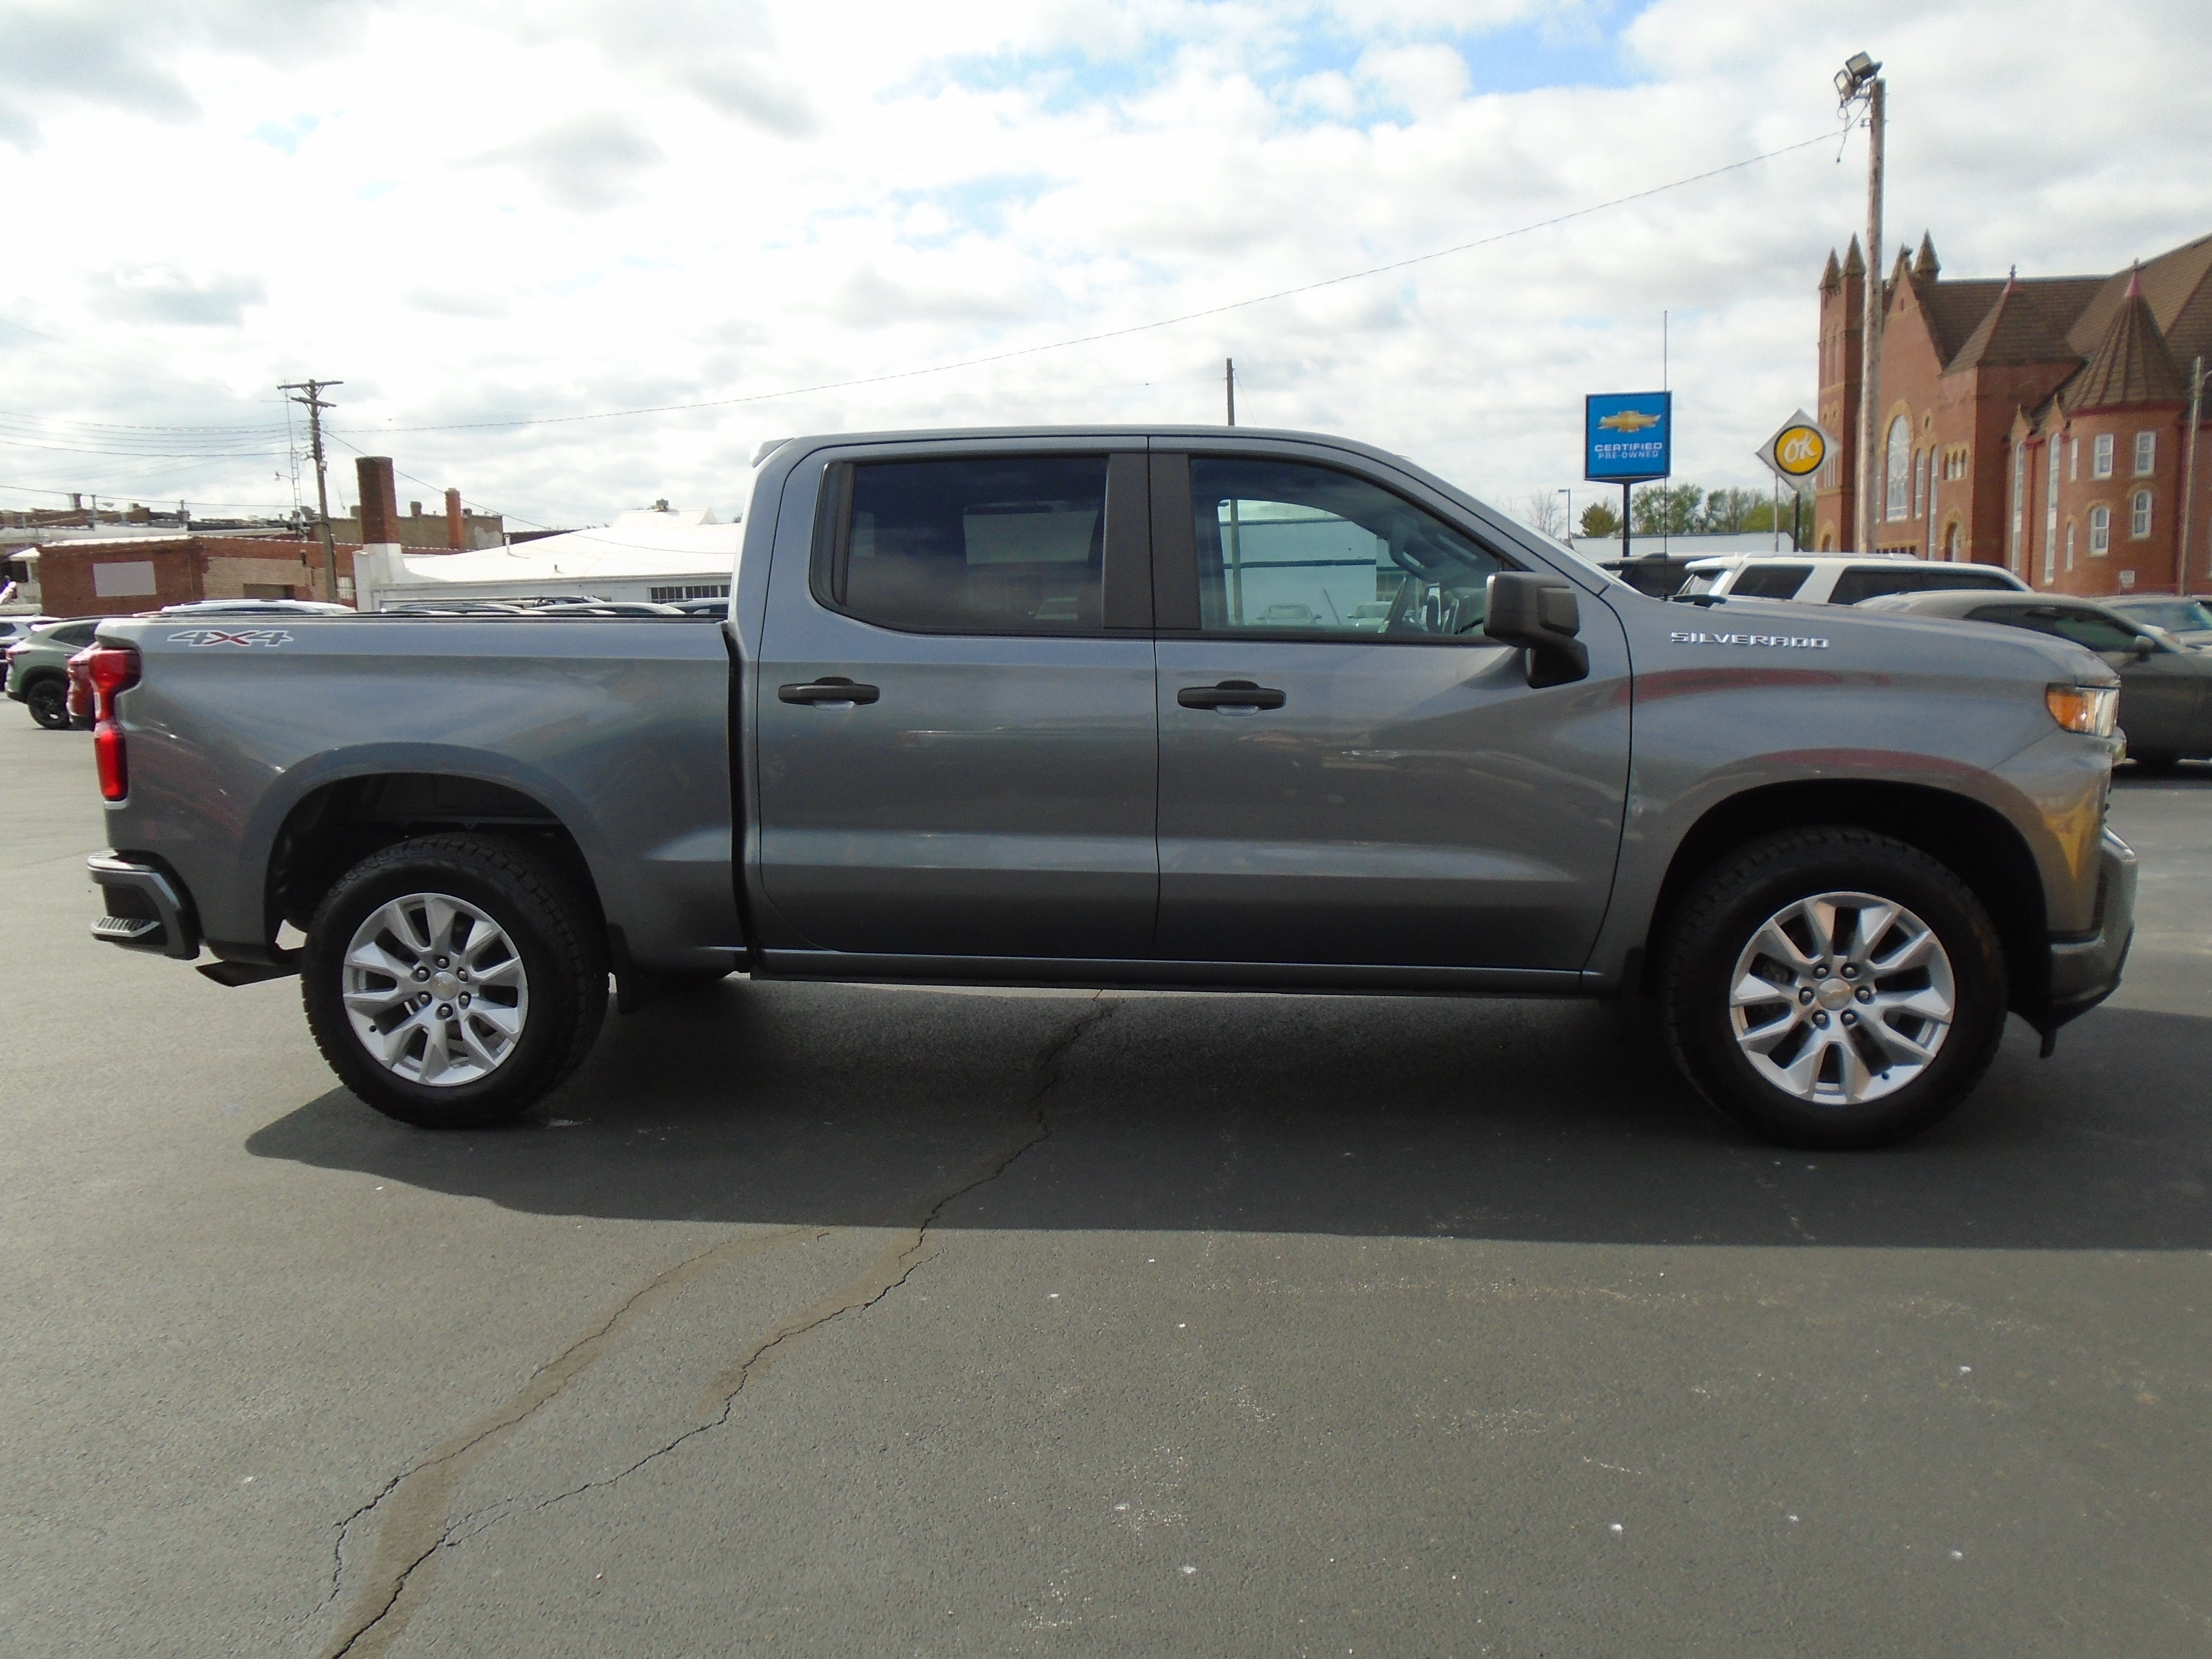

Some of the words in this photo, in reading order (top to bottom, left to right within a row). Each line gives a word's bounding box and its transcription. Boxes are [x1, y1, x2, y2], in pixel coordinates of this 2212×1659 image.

[1595, 442, 1662, 451] CERTIFIED
[1784, 432, 1817, 462] OK
[1671, 632, 1829, 648] SILVERADO
